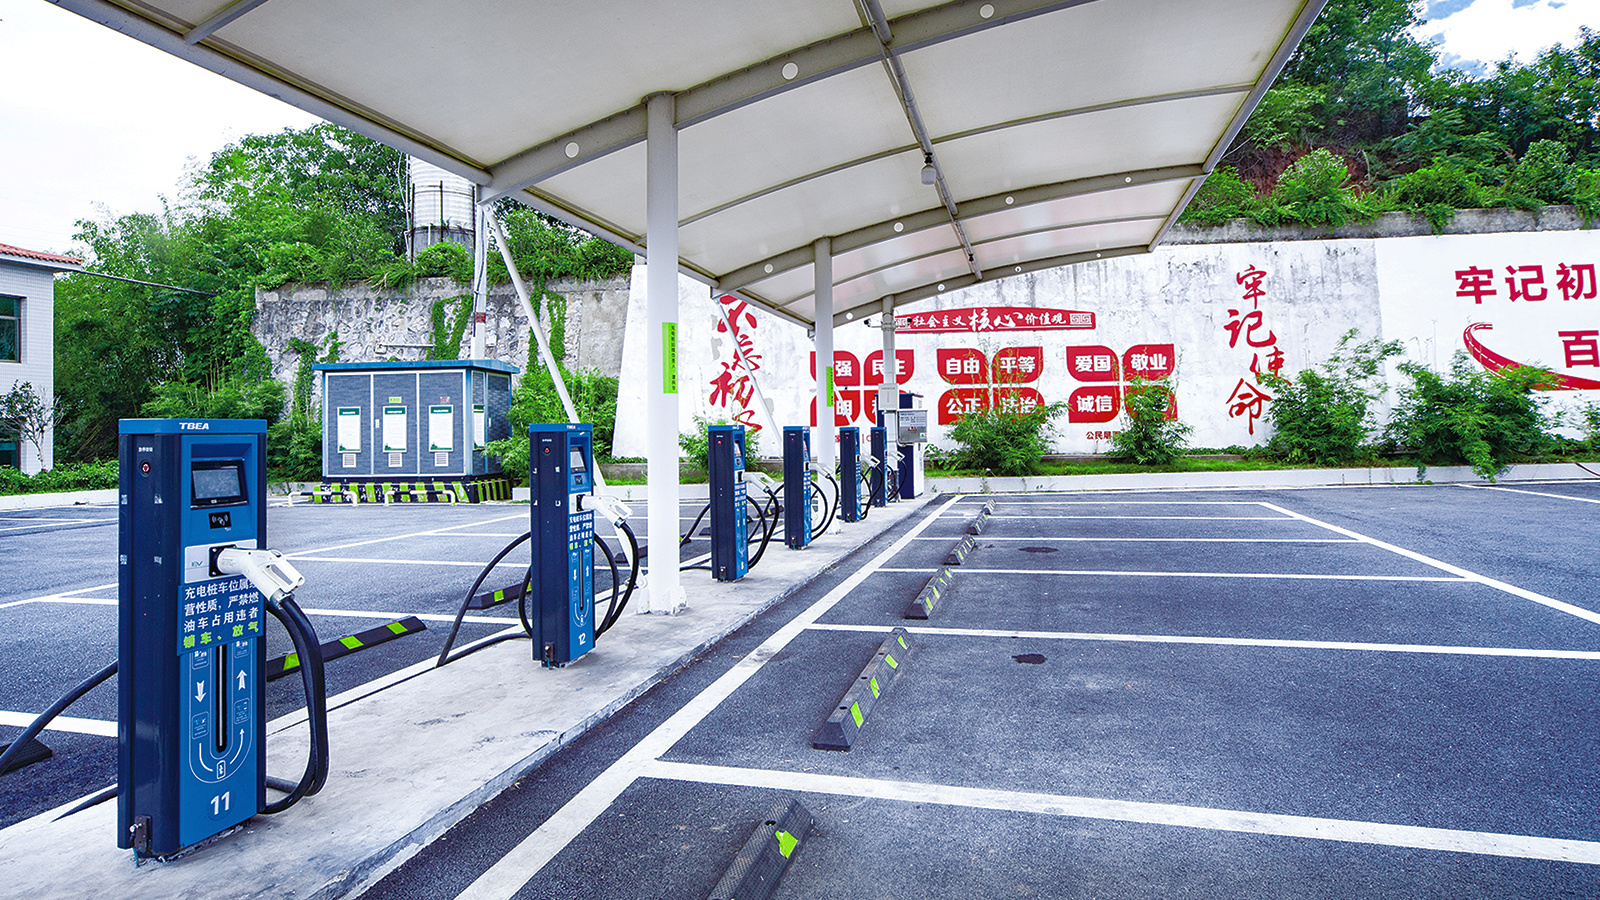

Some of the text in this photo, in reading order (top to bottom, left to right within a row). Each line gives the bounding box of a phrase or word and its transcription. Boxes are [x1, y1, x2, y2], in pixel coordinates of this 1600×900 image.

[1454, 262, 1598, 305] 牢记初
[913, 307, 1067, 332] 社会主义核心价值观
[1224, 264, 1292, 435] 牢记使命
[1557, 329, 1600, 369] 百
[946, 357, 980, 375] 自由
[1000, 355, 1036, 374] 平等
[1075, 355, 1111, 373] 爱国
[1130, 353, 1168, 371] 敬业
[946, 398, 982, 415] 公正
[1076, 395, 1113, 413] 诚信
[179, 422, 210, 431] TBEA
[184, 607, 259, 633] 油车占用违者
[578, 632, 586, 645] 12
[210, 791, 230, 815] 11
